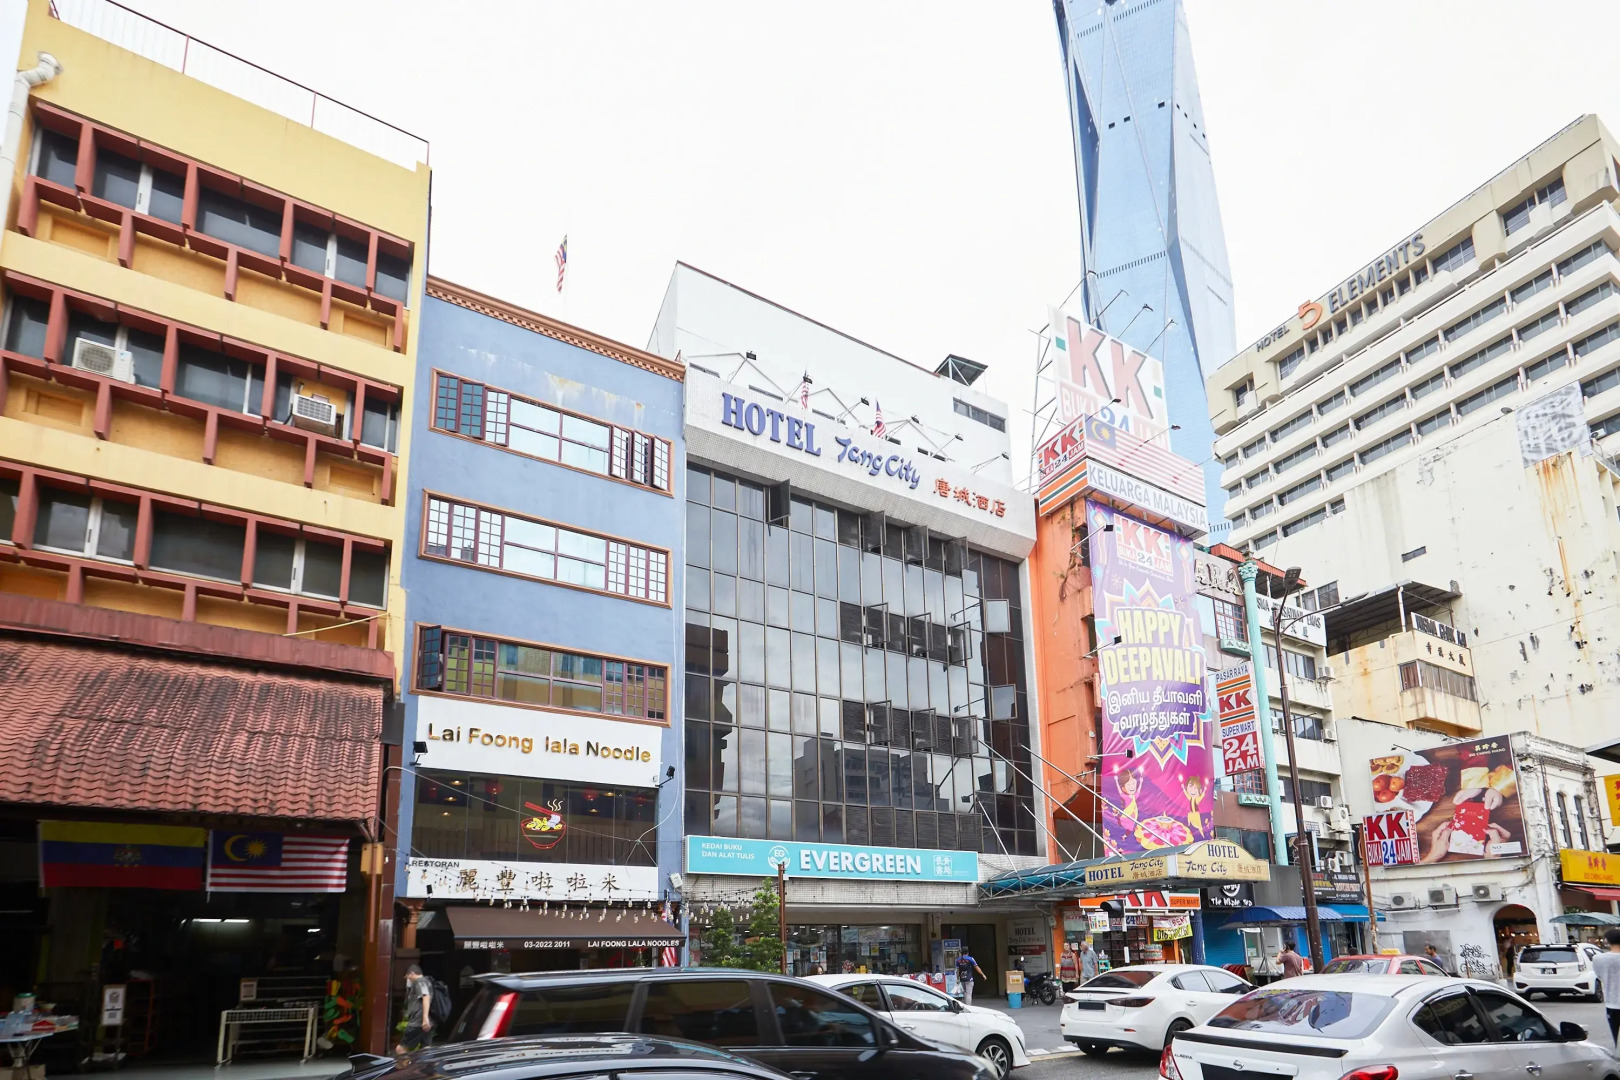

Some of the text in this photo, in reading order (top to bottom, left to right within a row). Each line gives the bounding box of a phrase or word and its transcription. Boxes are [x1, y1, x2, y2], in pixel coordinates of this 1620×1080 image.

[1256, 234, 1426, 353] HOTEL 5 ELEMENTS
[1067, 316, 1154, 420] KK
[721, 392, 921, 490] HOTEL Tang City
[1043, 425, 1079, 467] KK
[933, 478, 1007, 519] 唐城酒店
[1089, 464, 1207, 528] KELUARGA MALAYSIA
[1121, 518, 1165, 559] KK
[1138, 552, 1153, 567] 24
[1116, 609, 1184, 647] HAPPY
[1102, 648, 1202, 687] DEEPAVALI
[1219, 689, 1252, 714] KK
[428, 722, 461, 743] Lai
[468, 727, 534, 754] Foong
[586, 740, 652, 763] Noodle
[1223, 733, 1257, 761] 24
[1226, 754, 1260, 773] JAM
[1367, 812, 1407, 841] KK
[411, 860, 460, 868] RESTORAN
[702, 851, 717, 859] DAN
[736, 852, 755, 860] TULIS
[774, 849, 785, 858] EG
[799, 849, 922, 875] EVERGREEN
[1207, 844, 1239, 859] HOTEL
[1367, 840, 1412, 864] BUKA 24 JAM
[459, 868, 622, 894] 麗豐啦啦米
[1088, 858, 1164, 881] HOTEL Tang City
[1185, 860, 1228, 876] Tang City
[554, 940, 571, 948] 2011
[601, 940, 627, 948] FOONG
[627, 939, 646, 948] LALA
[647, 939, 680, 948] NOODLES
[1015, 927, 1036, 936] HOTEL
